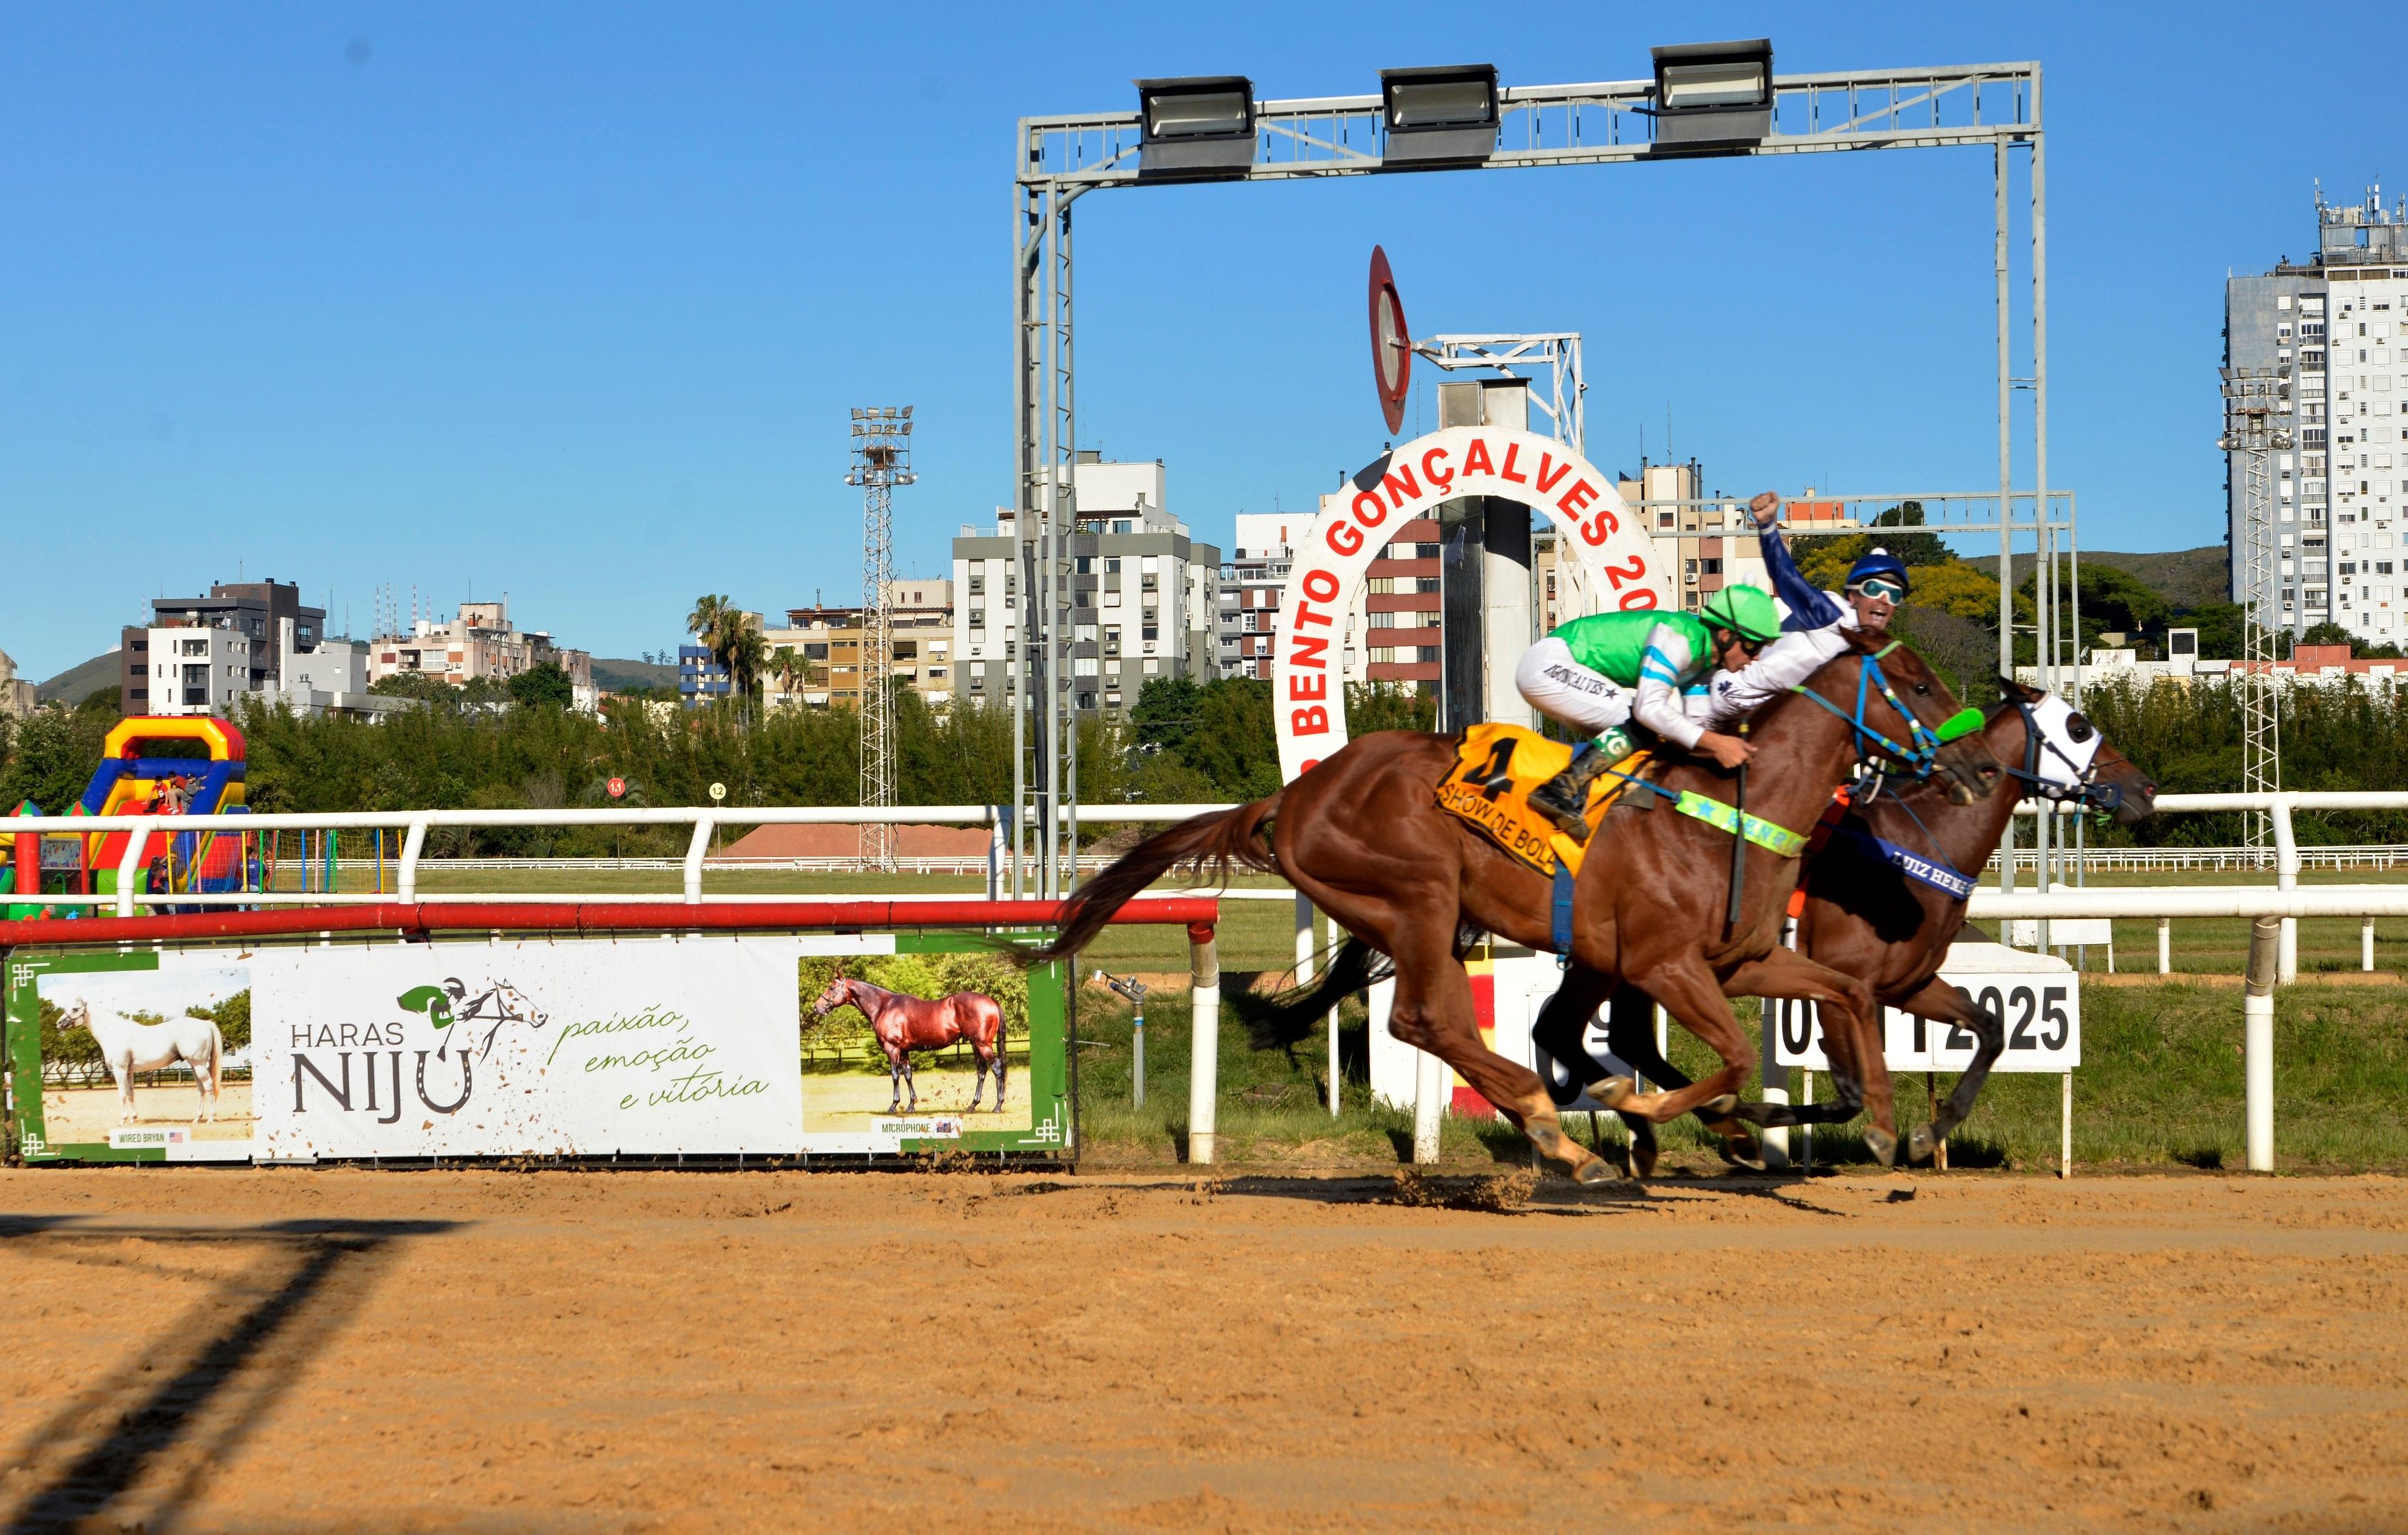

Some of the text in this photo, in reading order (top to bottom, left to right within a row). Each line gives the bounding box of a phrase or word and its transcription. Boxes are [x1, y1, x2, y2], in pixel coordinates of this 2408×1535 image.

[1289, 569, 1340, 737] BENTO
[1326, 438, 1619, 557] GONÇALVES
[1595, 726, 1628, 755] KG
[610, 782, 622, 792] 1.1
[1461, 736, 1519, 804] 4
[711, 787, 724, 795] 1.2
[1440, 782, 1557, 868] SHOW DE BOLA
[1891, 851, 1932, 878] LUIZ
[291, 1022, 404, 1048] HARAS
[547, 1003, 689, 1066] paixão,
[1945, 985, 2069, 1051] 2025
[585, 1036, 716, 1072] emoção
[290, 1050, 473, 1124] NIJU
[620, 1064, 770, 1109] e vitória
[119, 1133, 165, 1143] WIRED BRYAN
[882, 1123, 930, 1133] MICROPHONE
